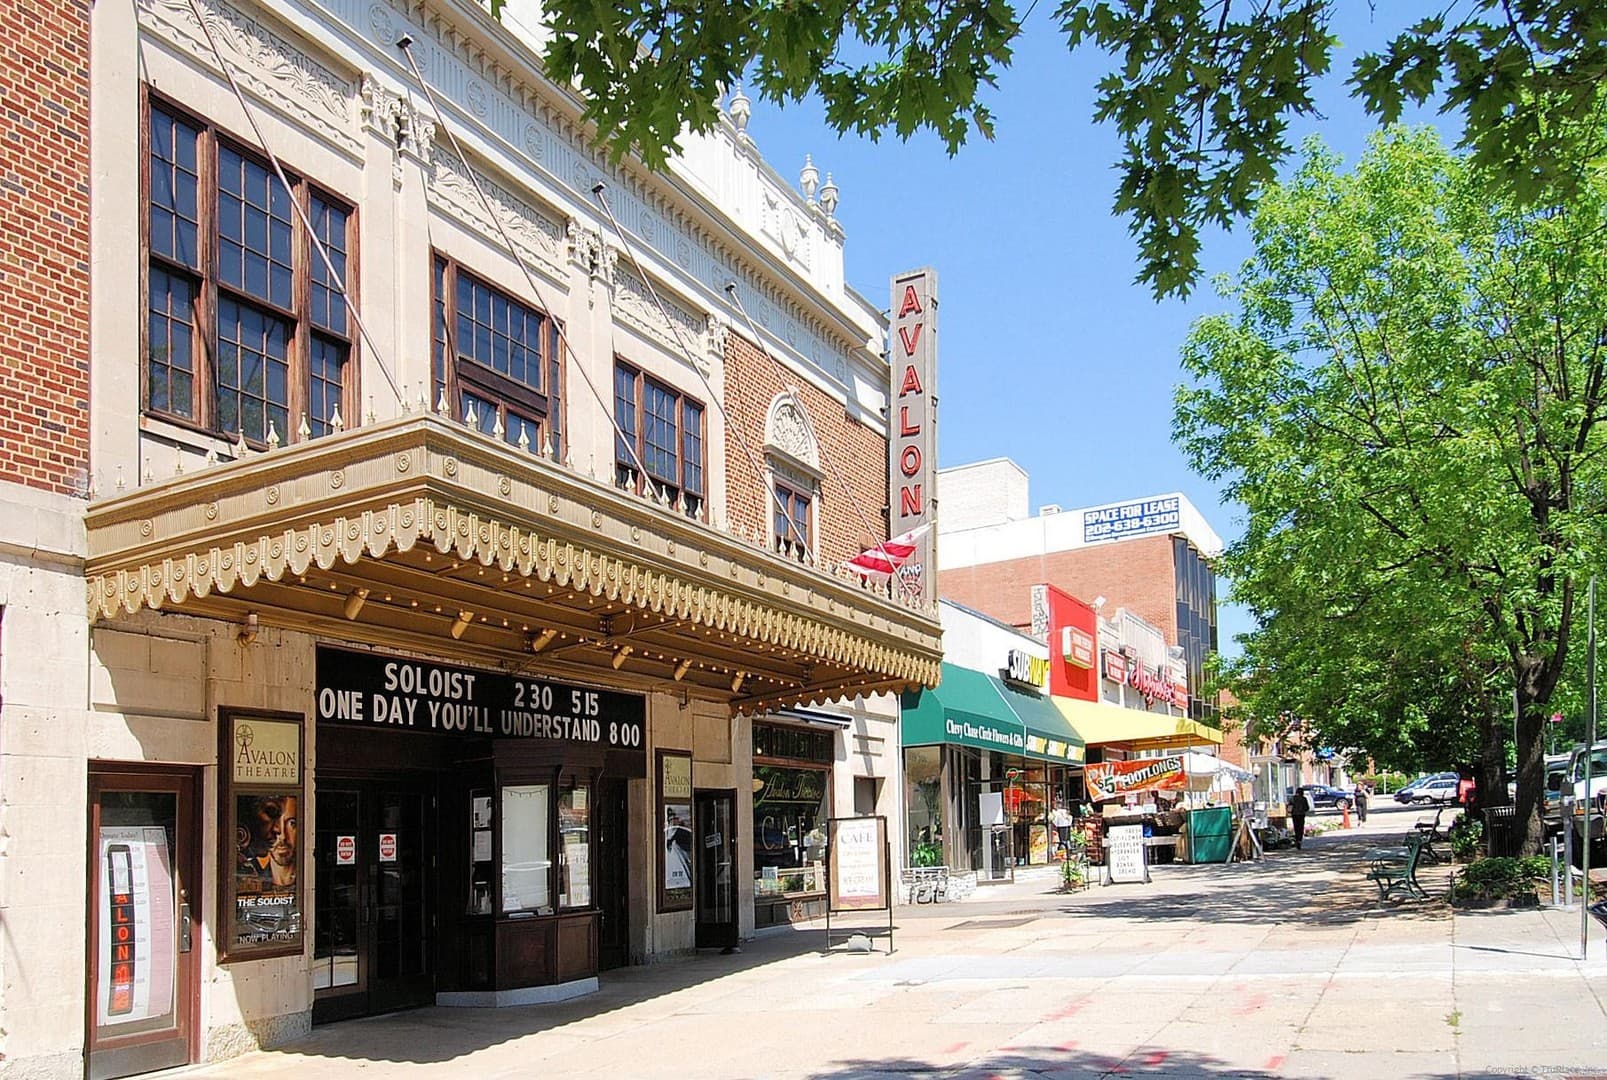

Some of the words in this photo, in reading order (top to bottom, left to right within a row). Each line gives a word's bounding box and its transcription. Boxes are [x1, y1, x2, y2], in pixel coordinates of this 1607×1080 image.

[899, 285, 922, 518] AVALON
[1085, 508, 1119, 524] SPACE
[1121, 504, 1142, 519] FOR
[1144, 499, 1178, 514] LEASE
[1010, 650, 1050, 687] SUBWAY
[384, 662, 476, 701] SOLOIST
[319, 687, 363, 720] ONE
[373, 694, 418, 725] DAY
[428, 701, 493, 733] YOU'LL
[501, 710, 601, 742] UNDERSTAND
[609, 722, 640, 747] 800
[946, 719, 963, 738] Chevy
[963, 722, 979, 738] Chase
[978, 725, 993, 741] Circle
[237, 741, 296, 765] AVALON
[236, 766, 297, 778] THEATRE
[1121, 757, 1182, 787] FOOTLONGS
[841, 831, 874, 845] CAFE
[237, 898, 256, 907] THE
[257, 896, 294, 906] SOLOIST
[239, 935, 258, 945] NOW
[261, 932, 294, 943] PLAYING
